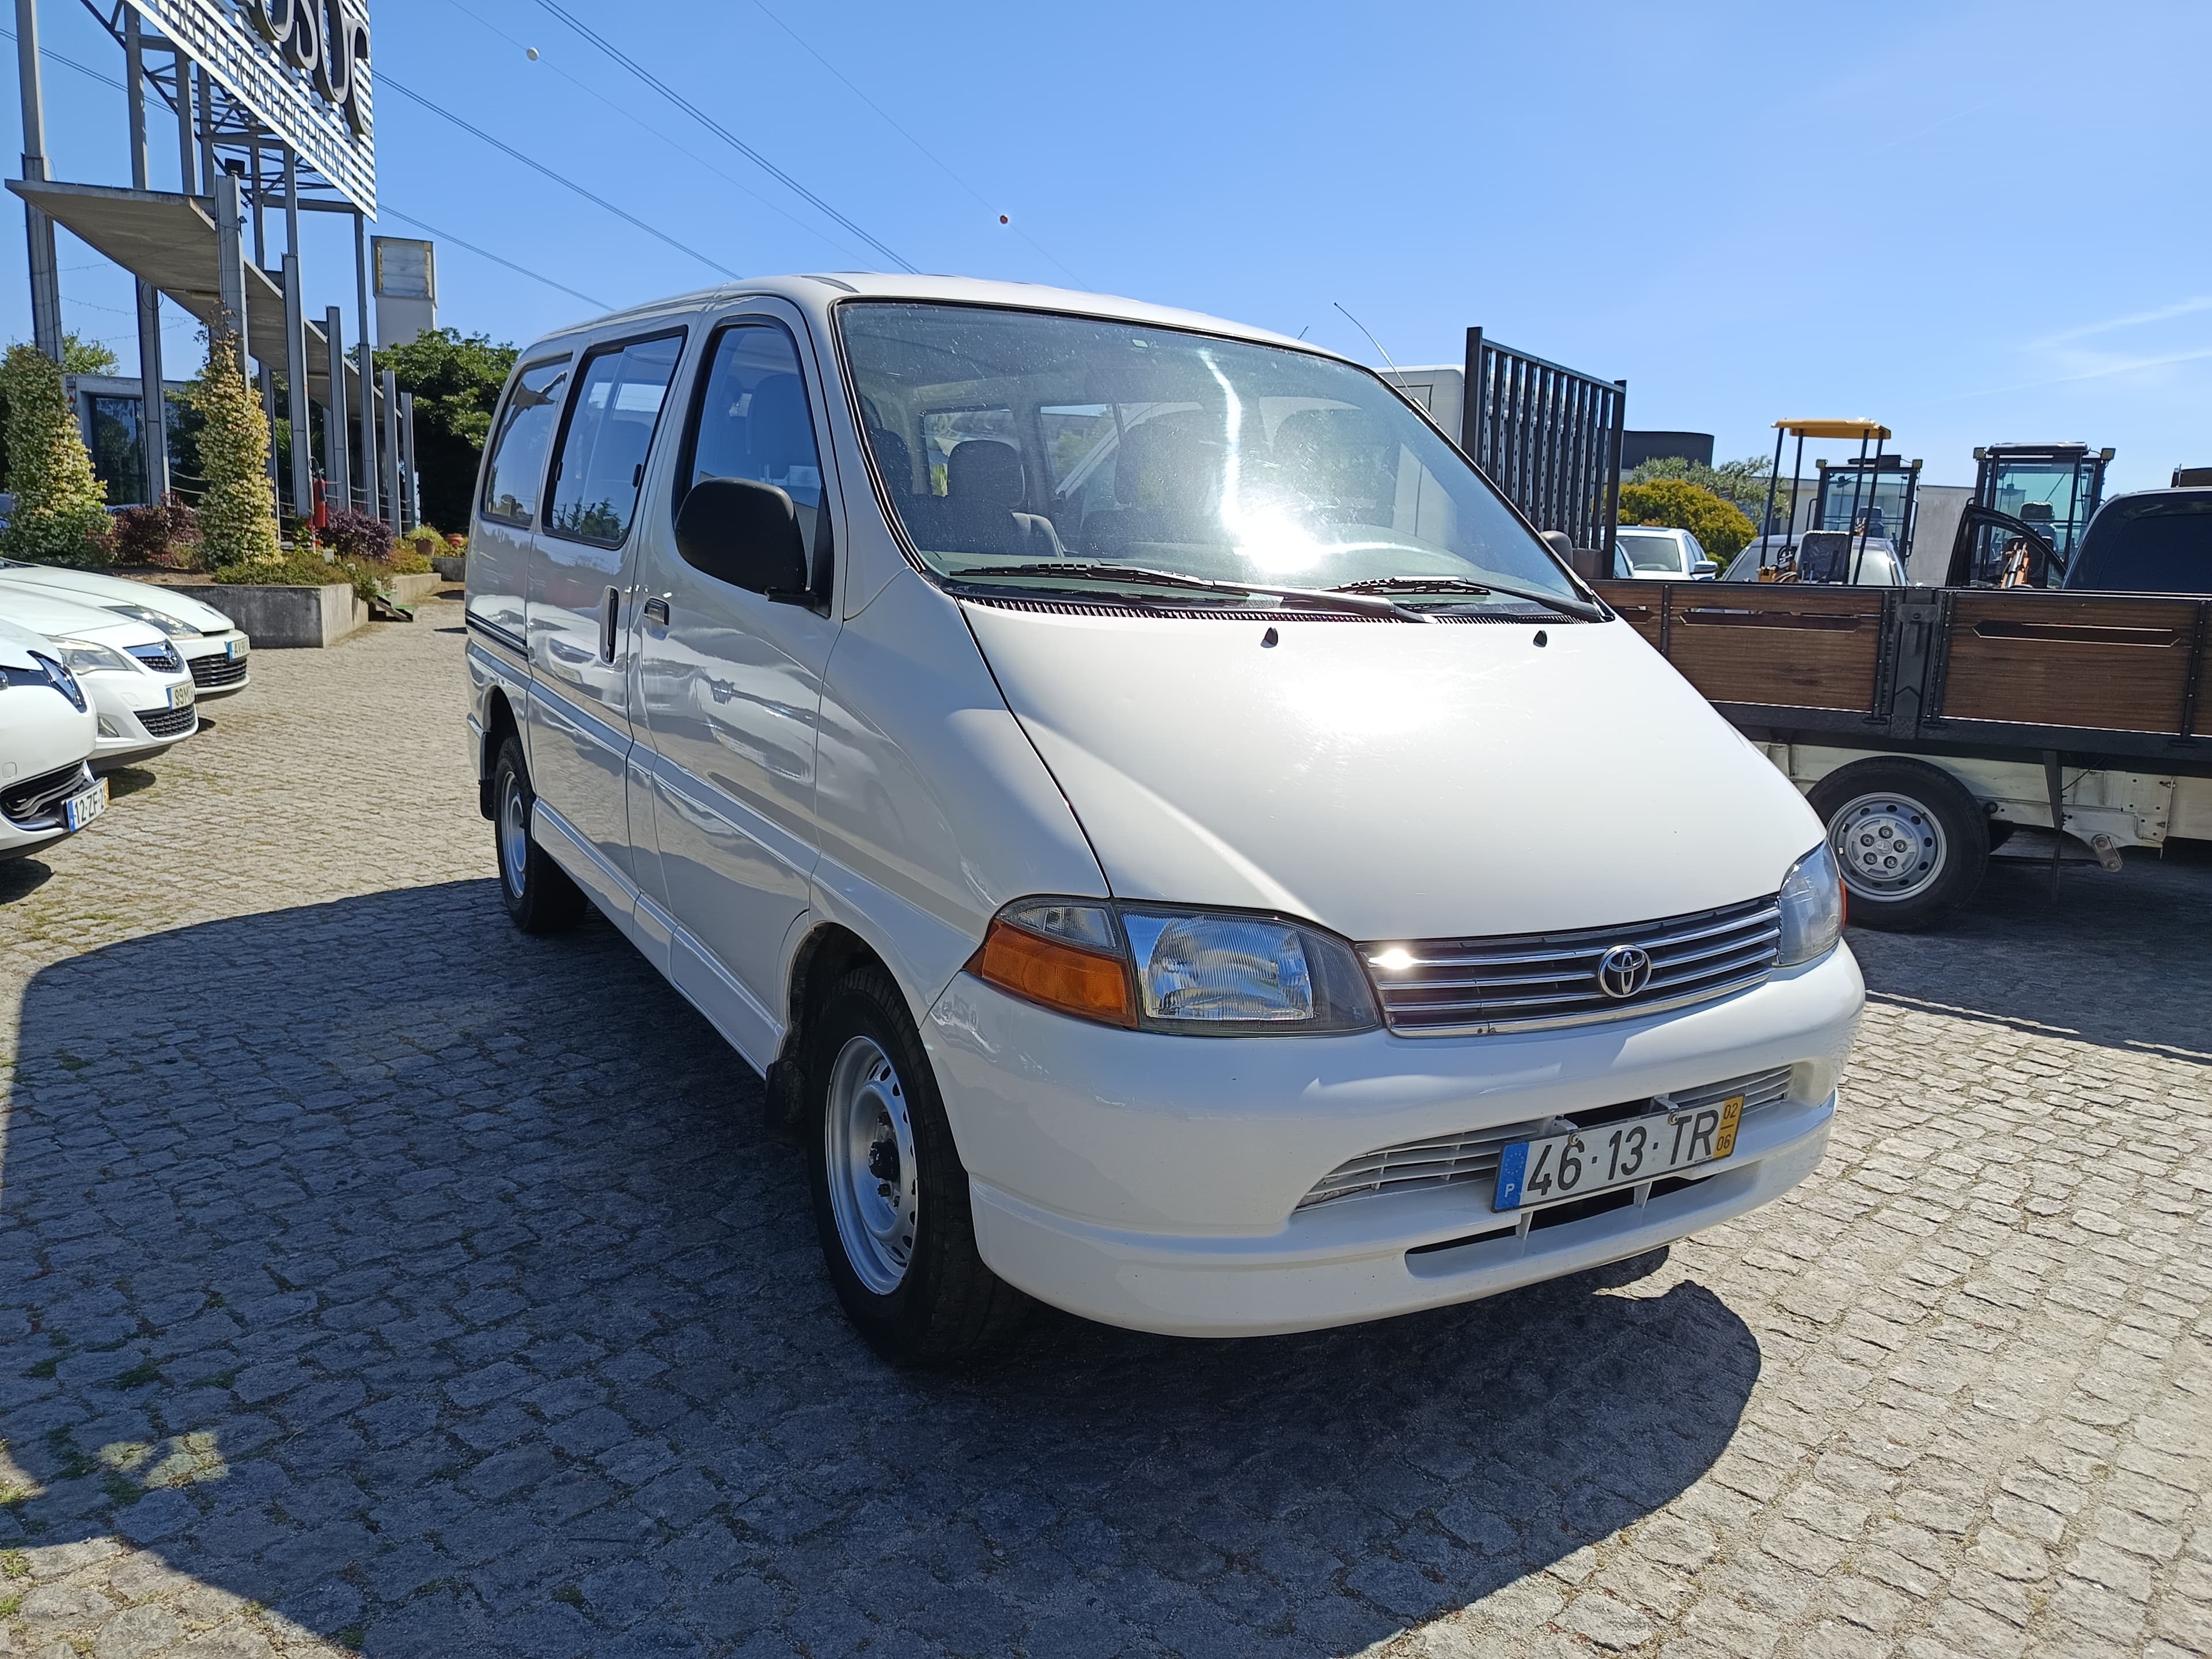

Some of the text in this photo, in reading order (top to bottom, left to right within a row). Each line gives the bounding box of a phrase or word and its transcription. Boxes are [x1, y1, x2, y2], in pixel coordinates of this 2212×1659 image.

[1723, 1103, 1738, 1120] 02
[1716, 1134, 1732, 1152] 06
[1504, 1183, 1516, 1198] P
